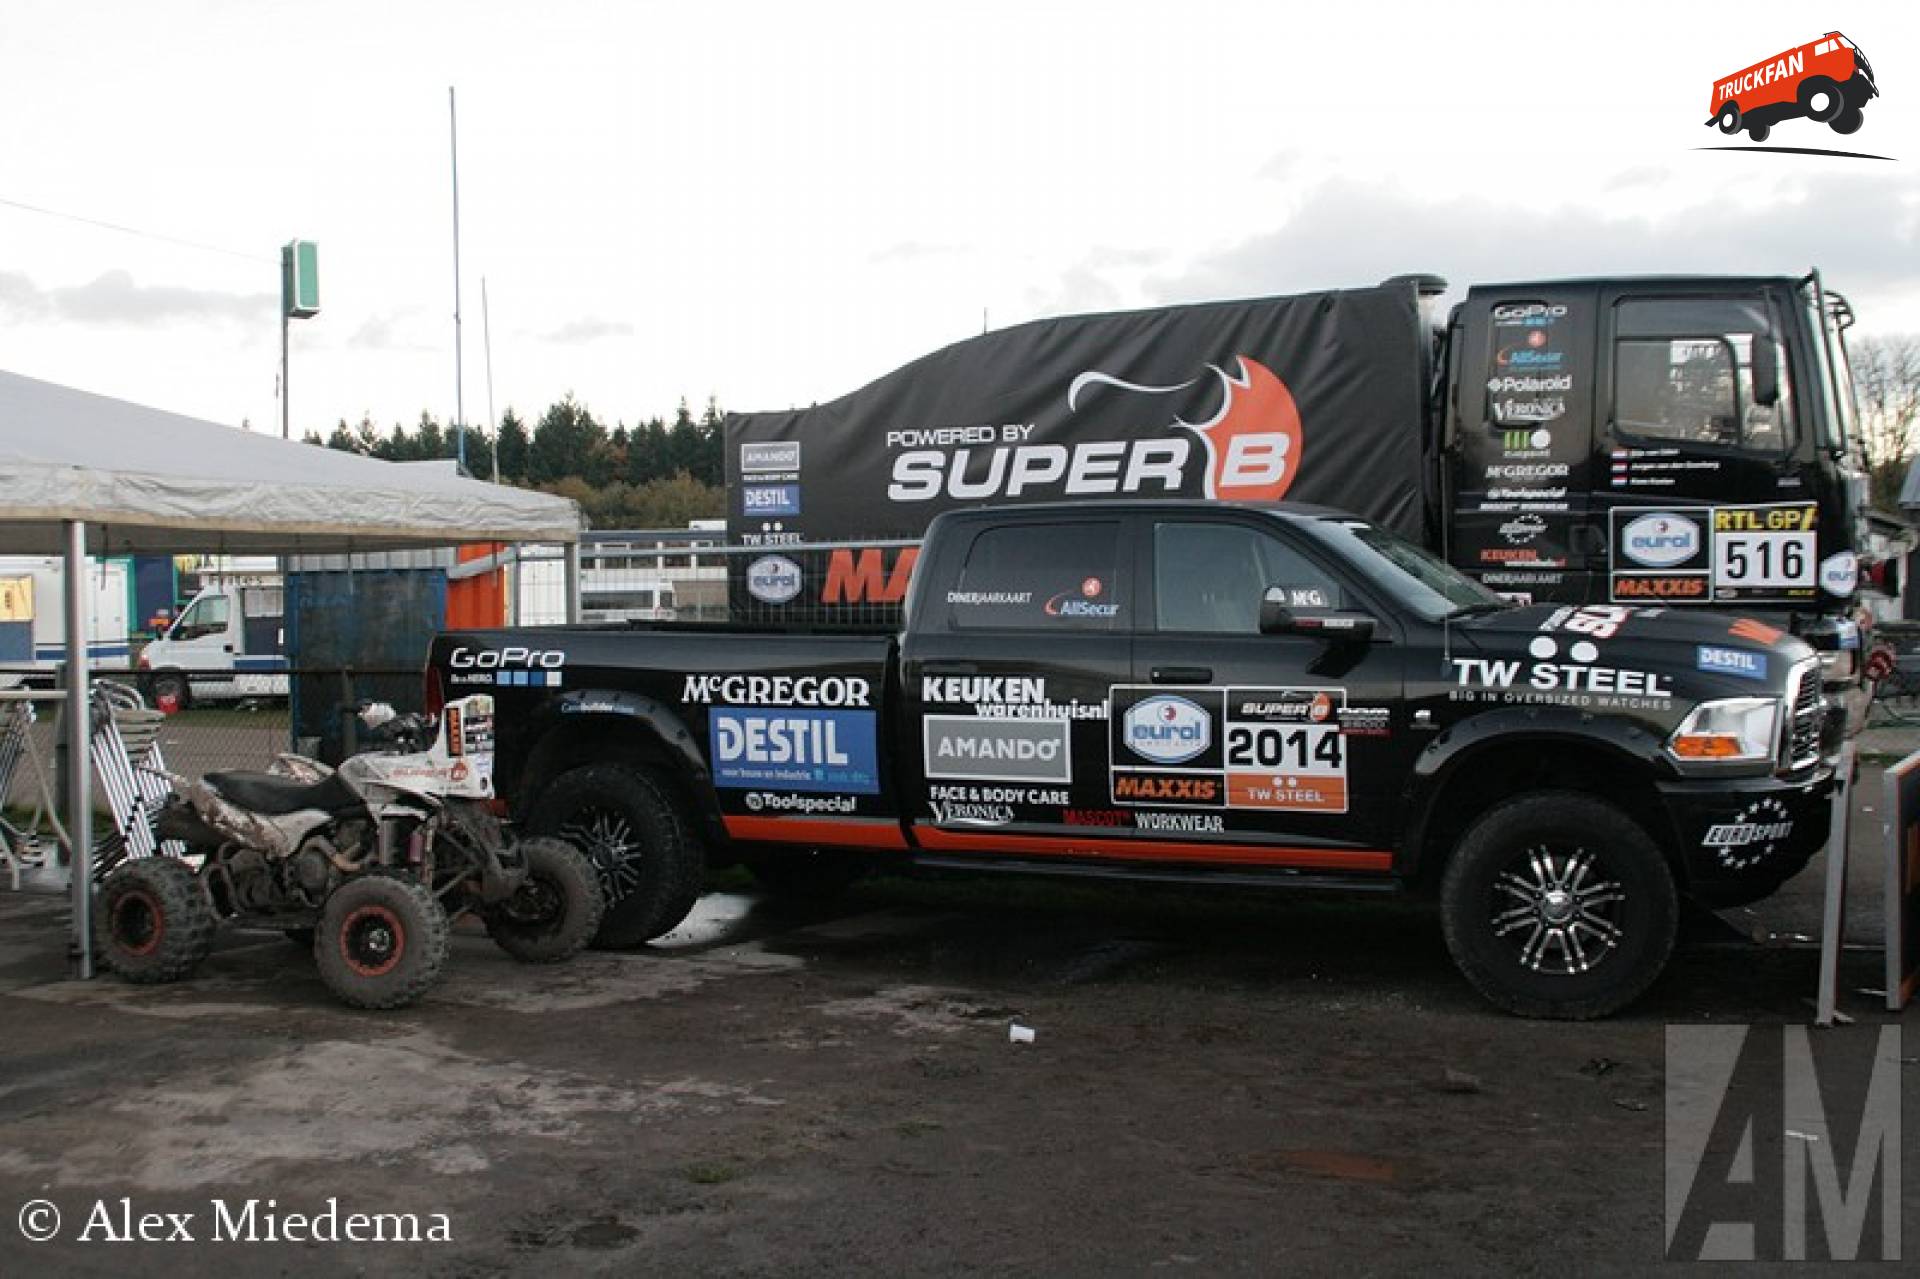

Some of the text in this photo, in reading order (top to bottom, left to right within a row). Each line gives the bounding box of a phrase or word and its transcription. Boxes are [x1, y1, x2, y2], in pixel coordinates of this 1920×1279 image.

[1503, 374, 1572, 391] Polaroid
[887, 424, 1035, 447] POWERED BY
[887, 432, 1291, 500] SUPER B
[745, 487, 791, 506] DESTIL
[1715, 511, 1763, 529] RTL
[1725, 540, 1803, 580] 516
[1615, 578, 1703, 596] MAXXIS
[450, 647, 566, 668] GoPro
[1700, 647, 1756, 671] DESTIL
[1453, 658, 1673, 697] TW STEEL
[681, 674, 870, 706] McGREGOR
[923, 677, 1045, 703] KEUKEN
[1450, 690, 1672, 711] BIG IN OVERSIZED WATCHES
[717, 717, 848, 766] DESTIL
[1132, 722, 1201, 741] eurol
[1228, 728, 1343, 768] 2014
[930, 786, 1070, 804] FACE & BODY CARE
[1116, 777, 1217, 800] MAXXIS
[1247, 786, 1326, 803] TW STEEL
[763, 793, 857, 813] Toolspecial
[1135, 811, 1225, 833] WORKWEAR
